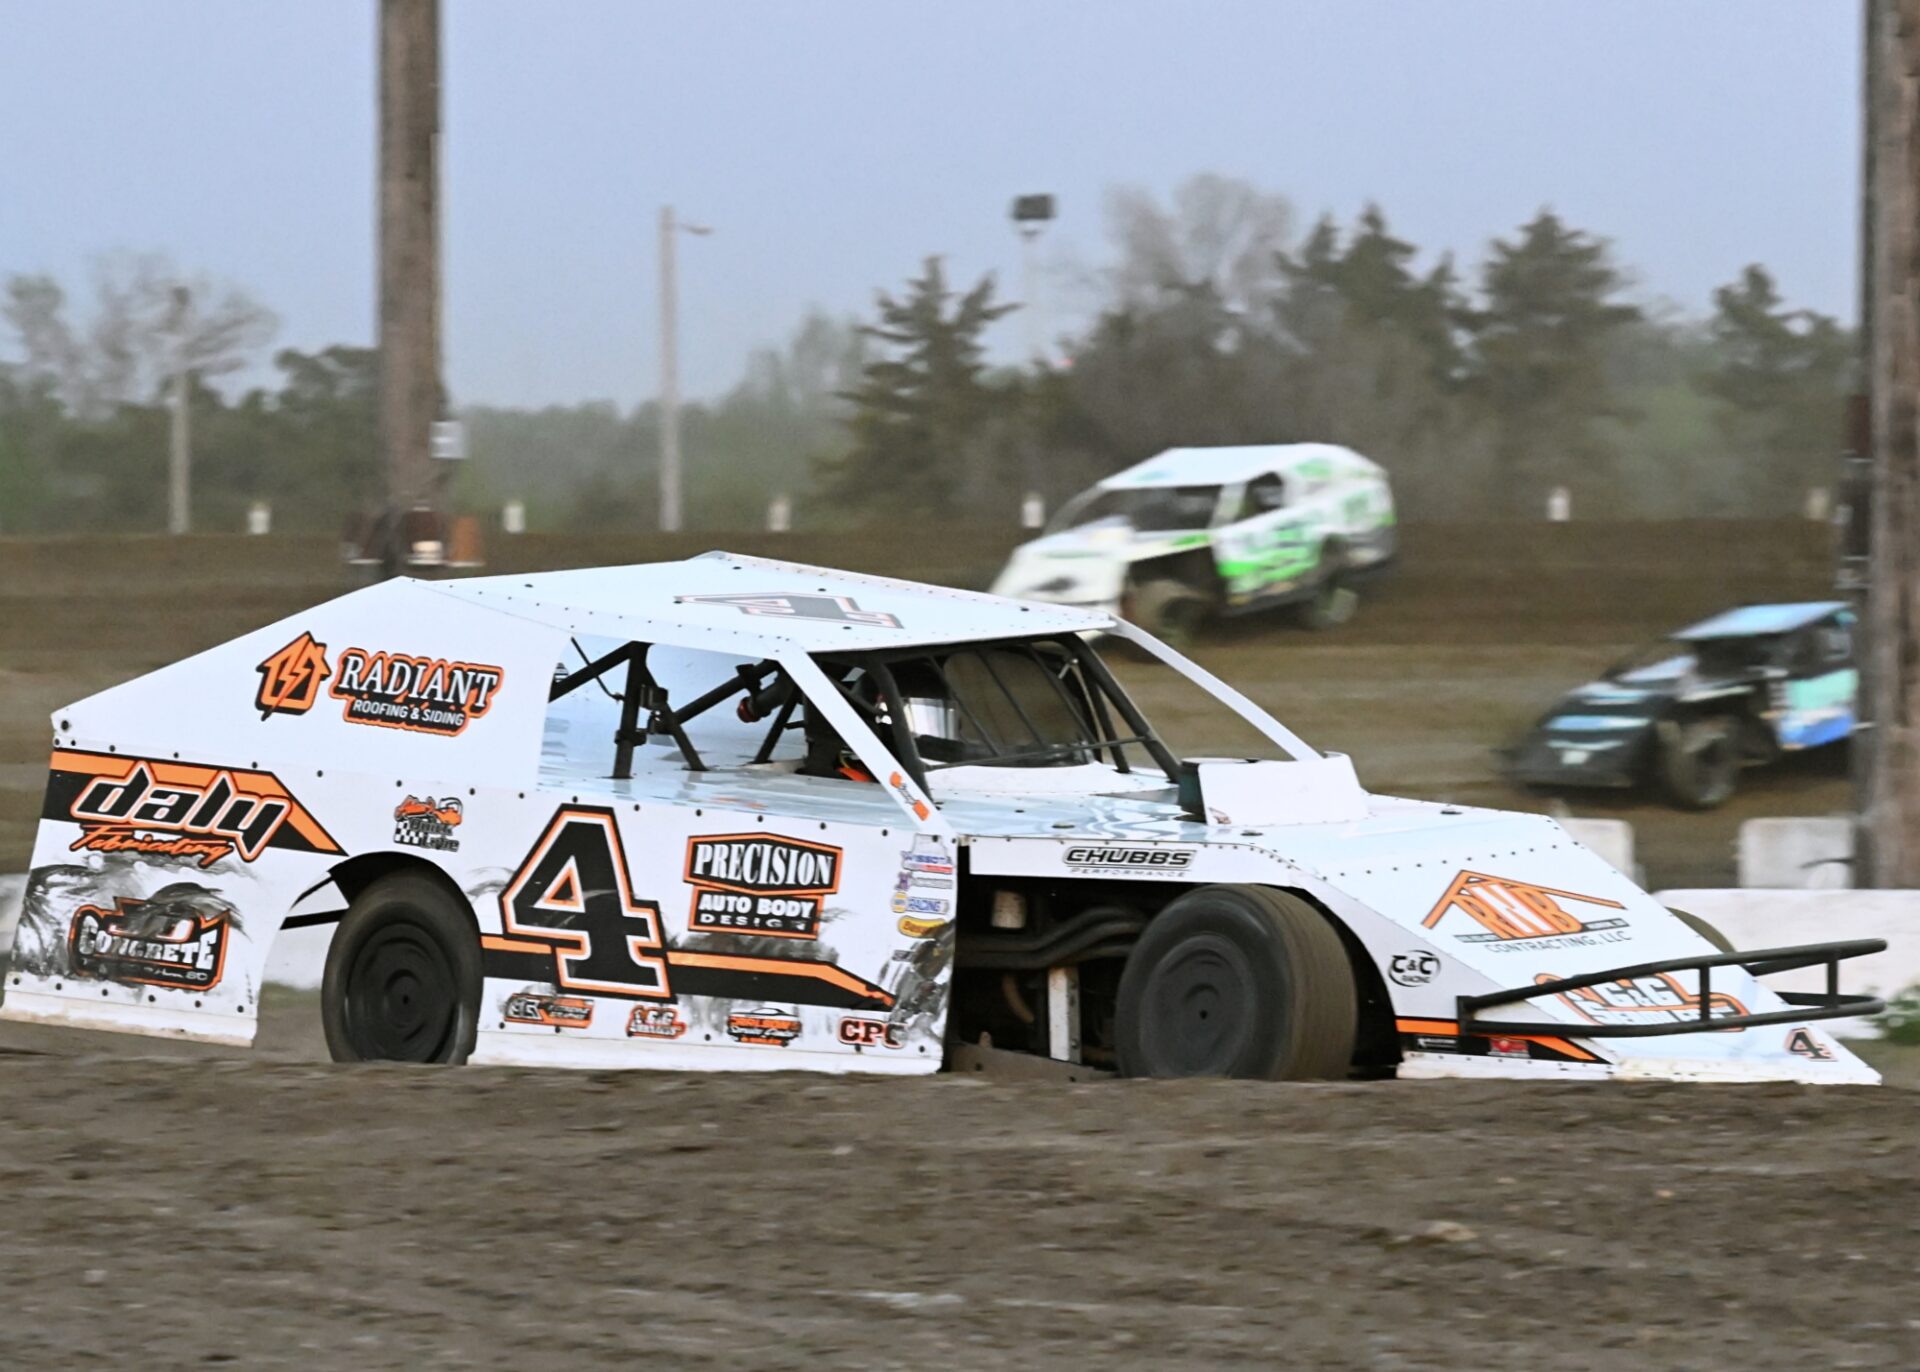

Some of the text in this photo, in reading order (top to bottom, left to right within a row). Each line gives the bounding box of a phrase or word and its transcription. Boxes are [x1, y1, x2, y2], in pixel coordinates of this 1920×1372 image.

[338, 655, 499, 707] RADIANT
[352, 699, 465, 727] ROOFING & SIDING
[72, 762, 288, 860] daly
[693, 843, 834, 887] PRECISION
[1066, 849, 1191, 865] CHUBBS
[1070, 867, 1186, 878] PERFORMANCE
[499, 803, 678, 1004] 4
[698, 894, 815, 918] AUTO BODY
[79, 915, 218, 971] CONCRETE
[1603, 931, 1632, 943] LLC
[1391, 953, 1434, 974] C&C
[1782, 1028, 1836, 1064] 4
